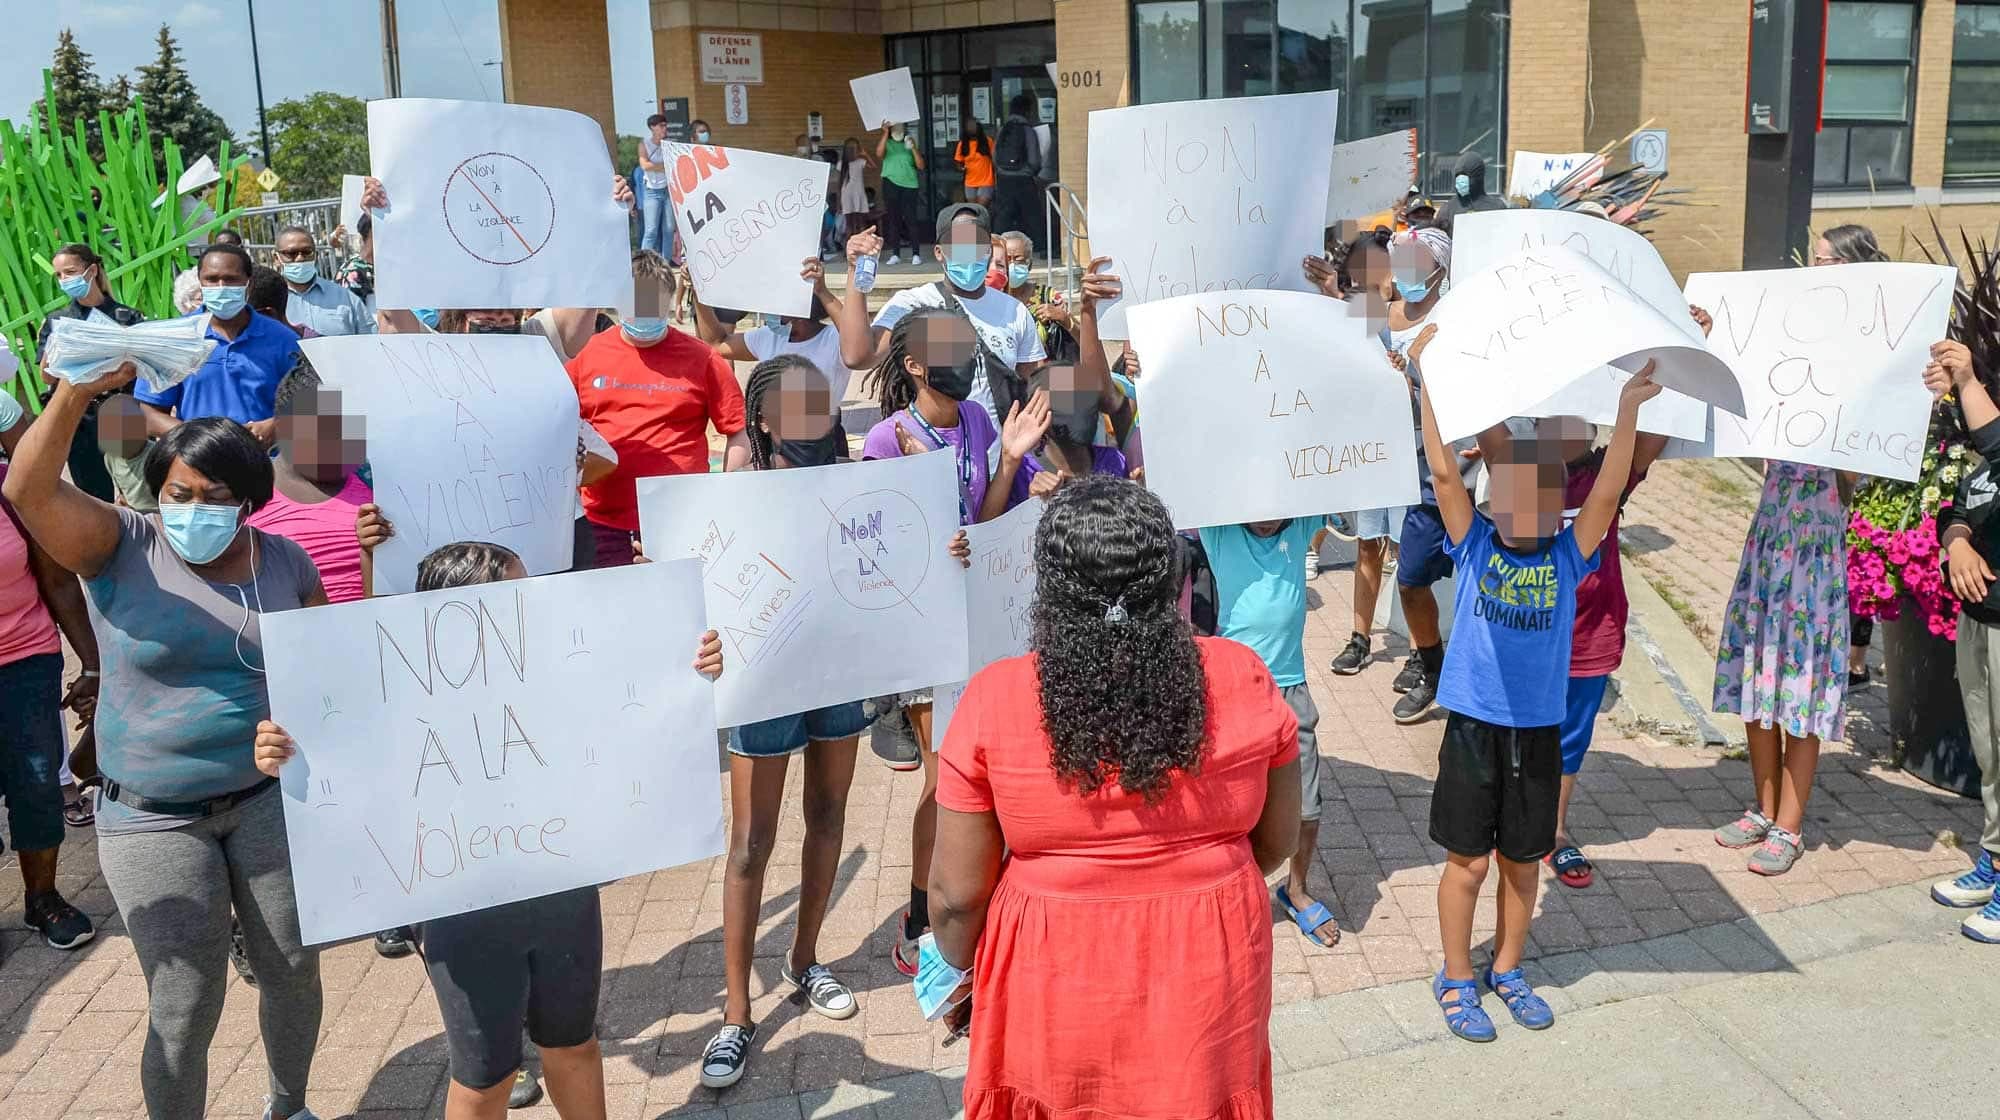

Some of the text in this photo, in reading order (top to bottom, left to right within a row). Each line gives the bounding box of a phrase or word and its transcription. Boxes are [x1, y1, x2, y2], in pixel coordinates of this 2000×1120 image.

[709, 36, 753, 46] DÉFENSE
[725, 47, 738, 56] DE
[1060, 70, 1105, 88] 9001
[686, 191, 727, 235] LA
[1166, 185, 1269, 225] à la
[1196, 303, 1270, 346] NON
[1711, 278, 1944, 357] NON
[379, 339, 497, 408] NON
[1768, 350, 1837, 397] à
[1269, 388, 1315, 418] LA
[463, 443, 505, 474] LA
[1473, 594, 1554, 632] DOMINATE
[375, 587, 526, 704] NON
[411, 703, 549, 798] À LA
[363, 810, 571, 896] Violence
